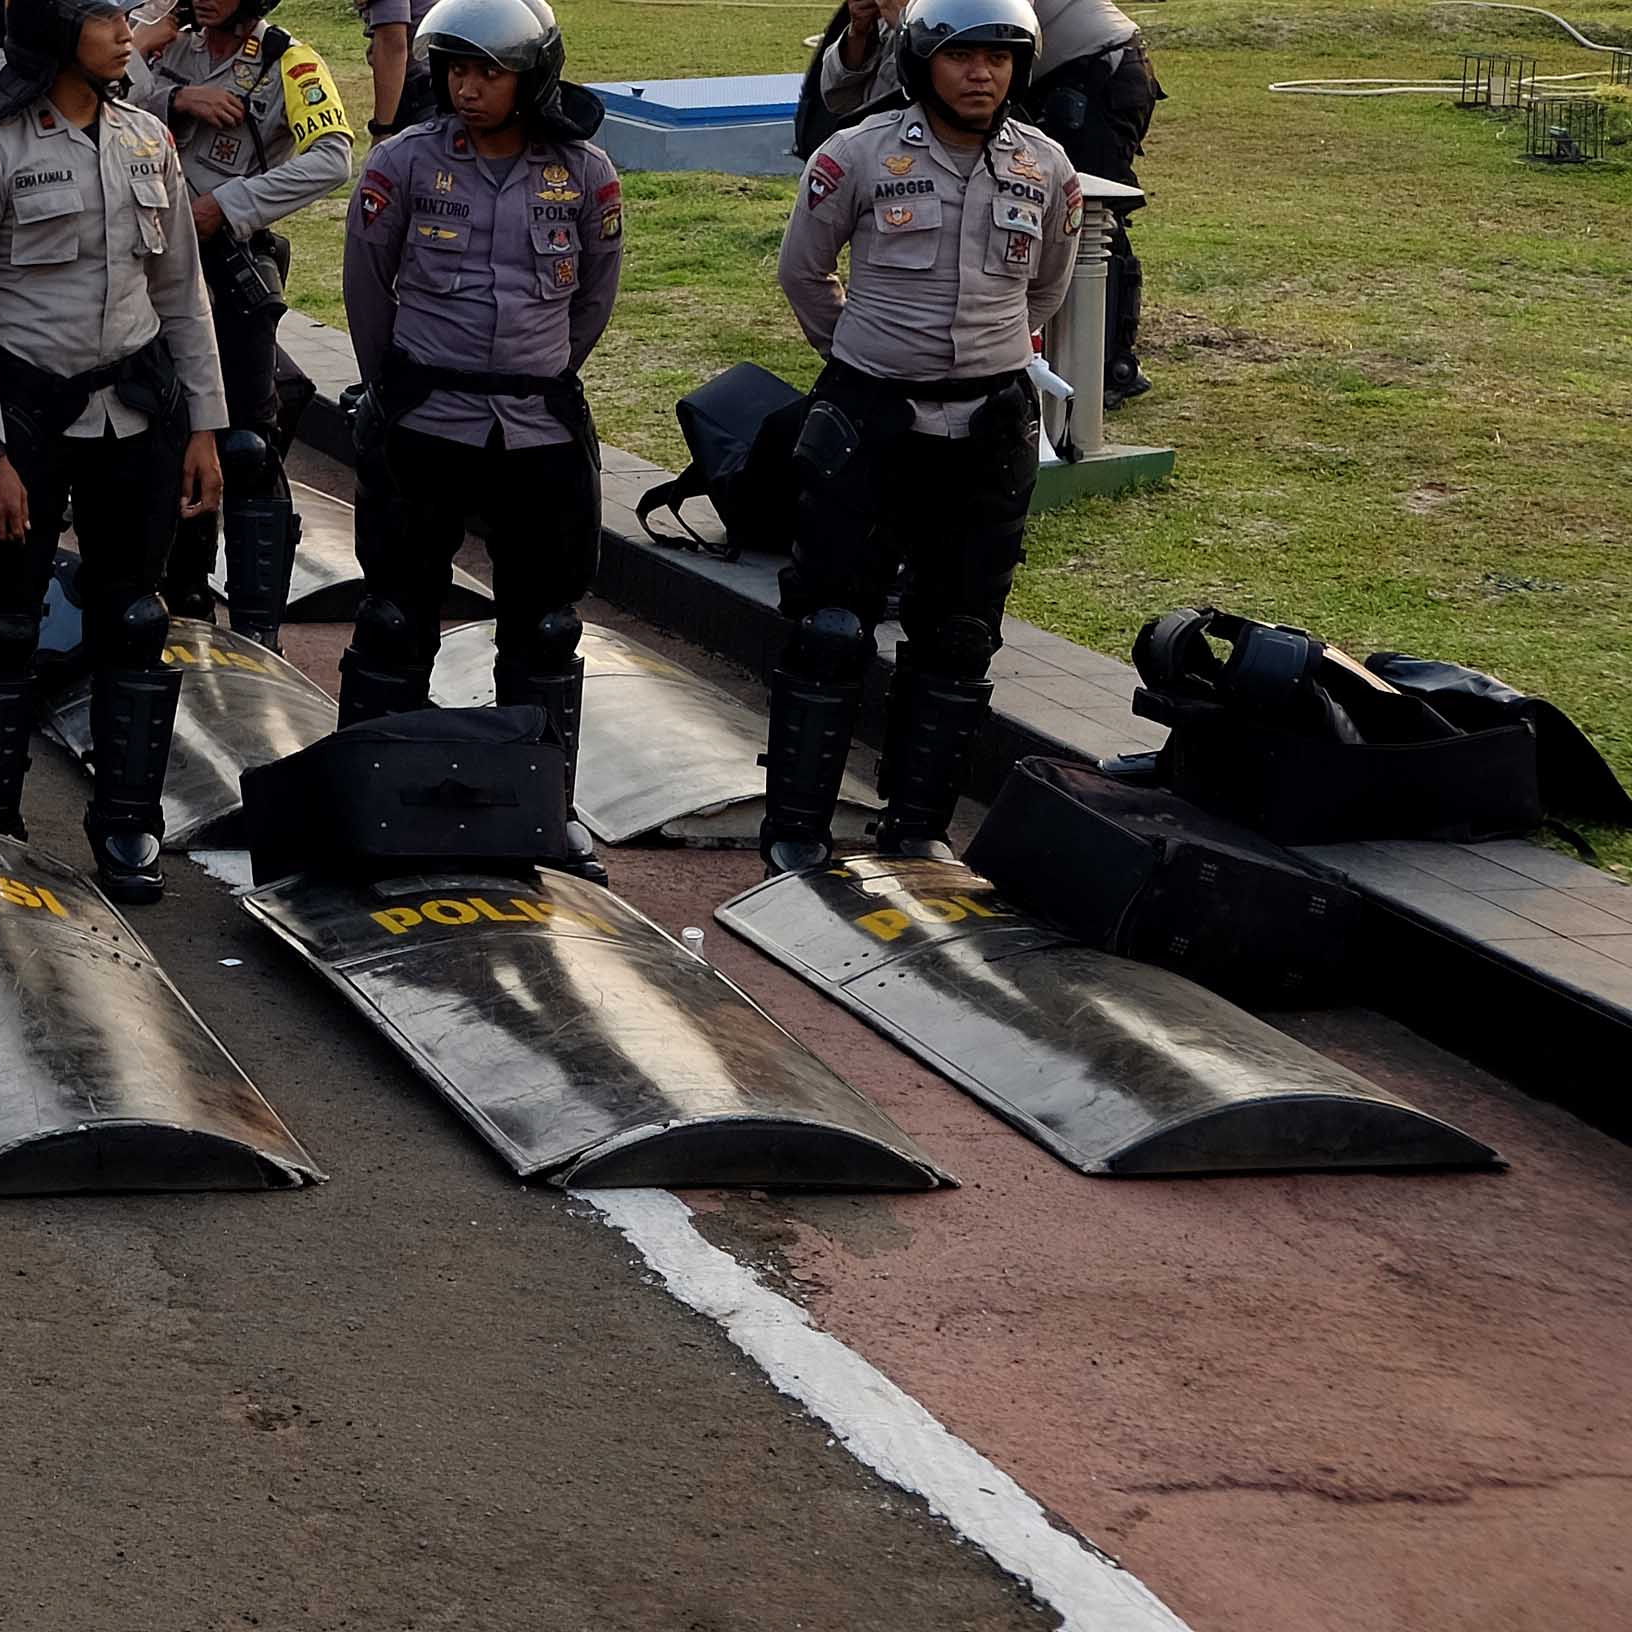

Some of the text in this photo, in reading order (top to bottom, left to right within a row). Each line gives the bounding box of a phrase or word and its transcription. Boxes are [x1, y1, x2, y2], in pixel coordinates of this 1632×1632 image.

[874, 180, 936, 199] ANGGER
[368, 896, 622, 936] POLISI
[855, 895, 1015, 942] POL
